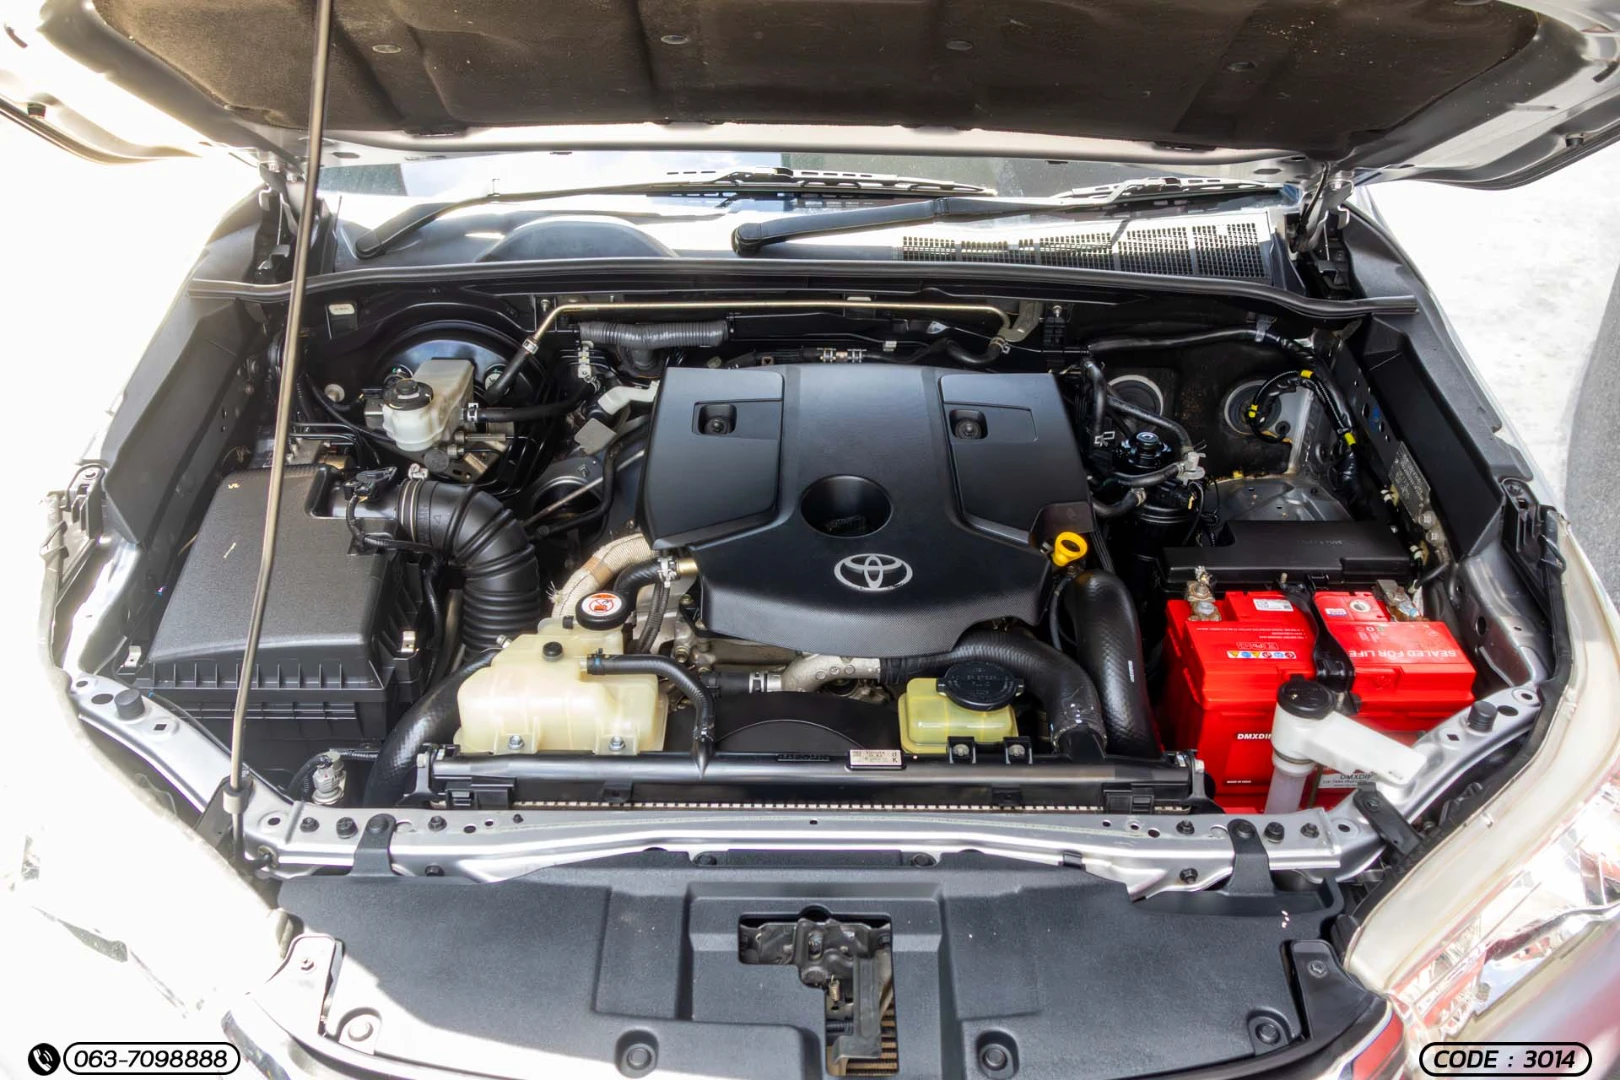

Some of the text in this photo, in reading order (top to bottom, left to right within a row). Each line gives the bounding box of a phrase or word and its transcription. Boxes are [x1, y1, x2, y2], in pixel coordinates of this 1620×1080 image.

[1349, 649, 1457, 657] SEALED FOR LIFE
